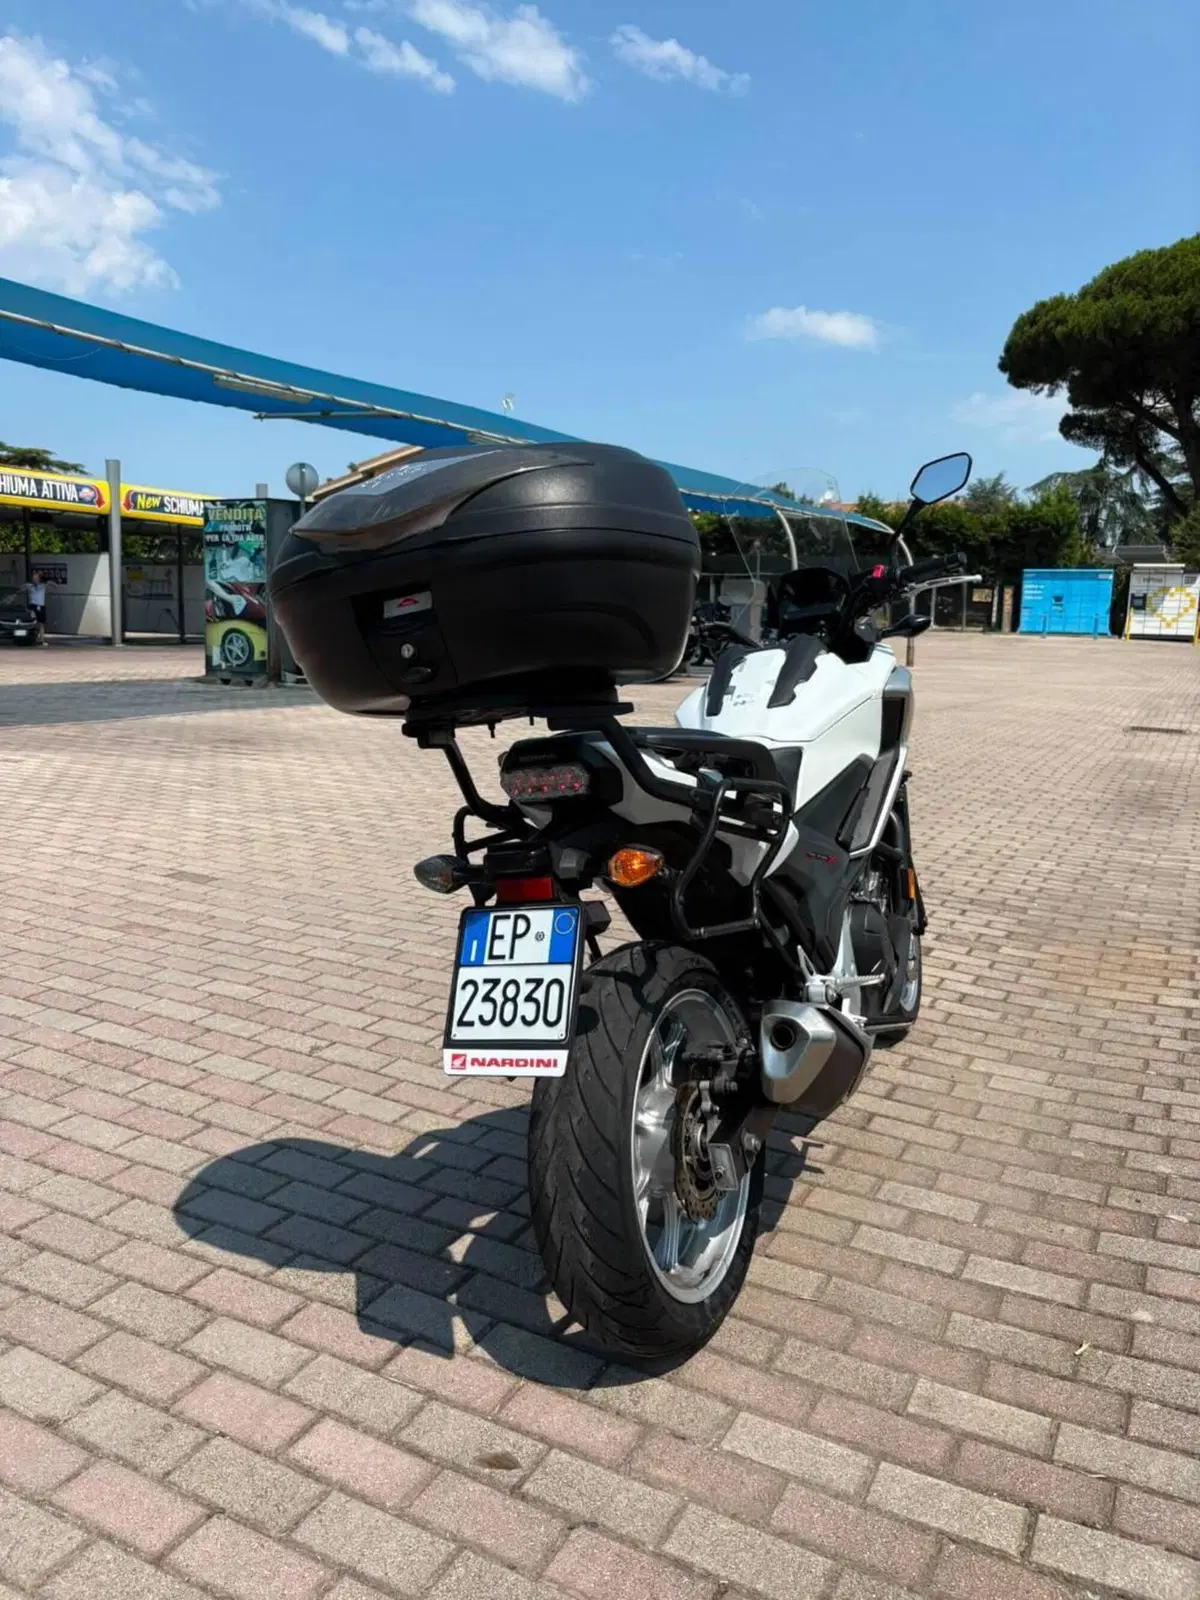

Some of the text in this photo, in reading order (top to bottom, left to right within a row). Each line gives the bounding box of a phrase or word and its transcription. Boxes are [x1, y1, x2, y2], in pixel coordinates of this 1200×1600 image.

[41, 480, 79, 502] ATTIVA
[136, 493, 161, 509] New
[207, 507, 265, 521] VENDITA
[487, 914, 531, 960] EP
[456, 978, 565, 1028] 23830
[470, 1057, 558, 1068] NARDINI
